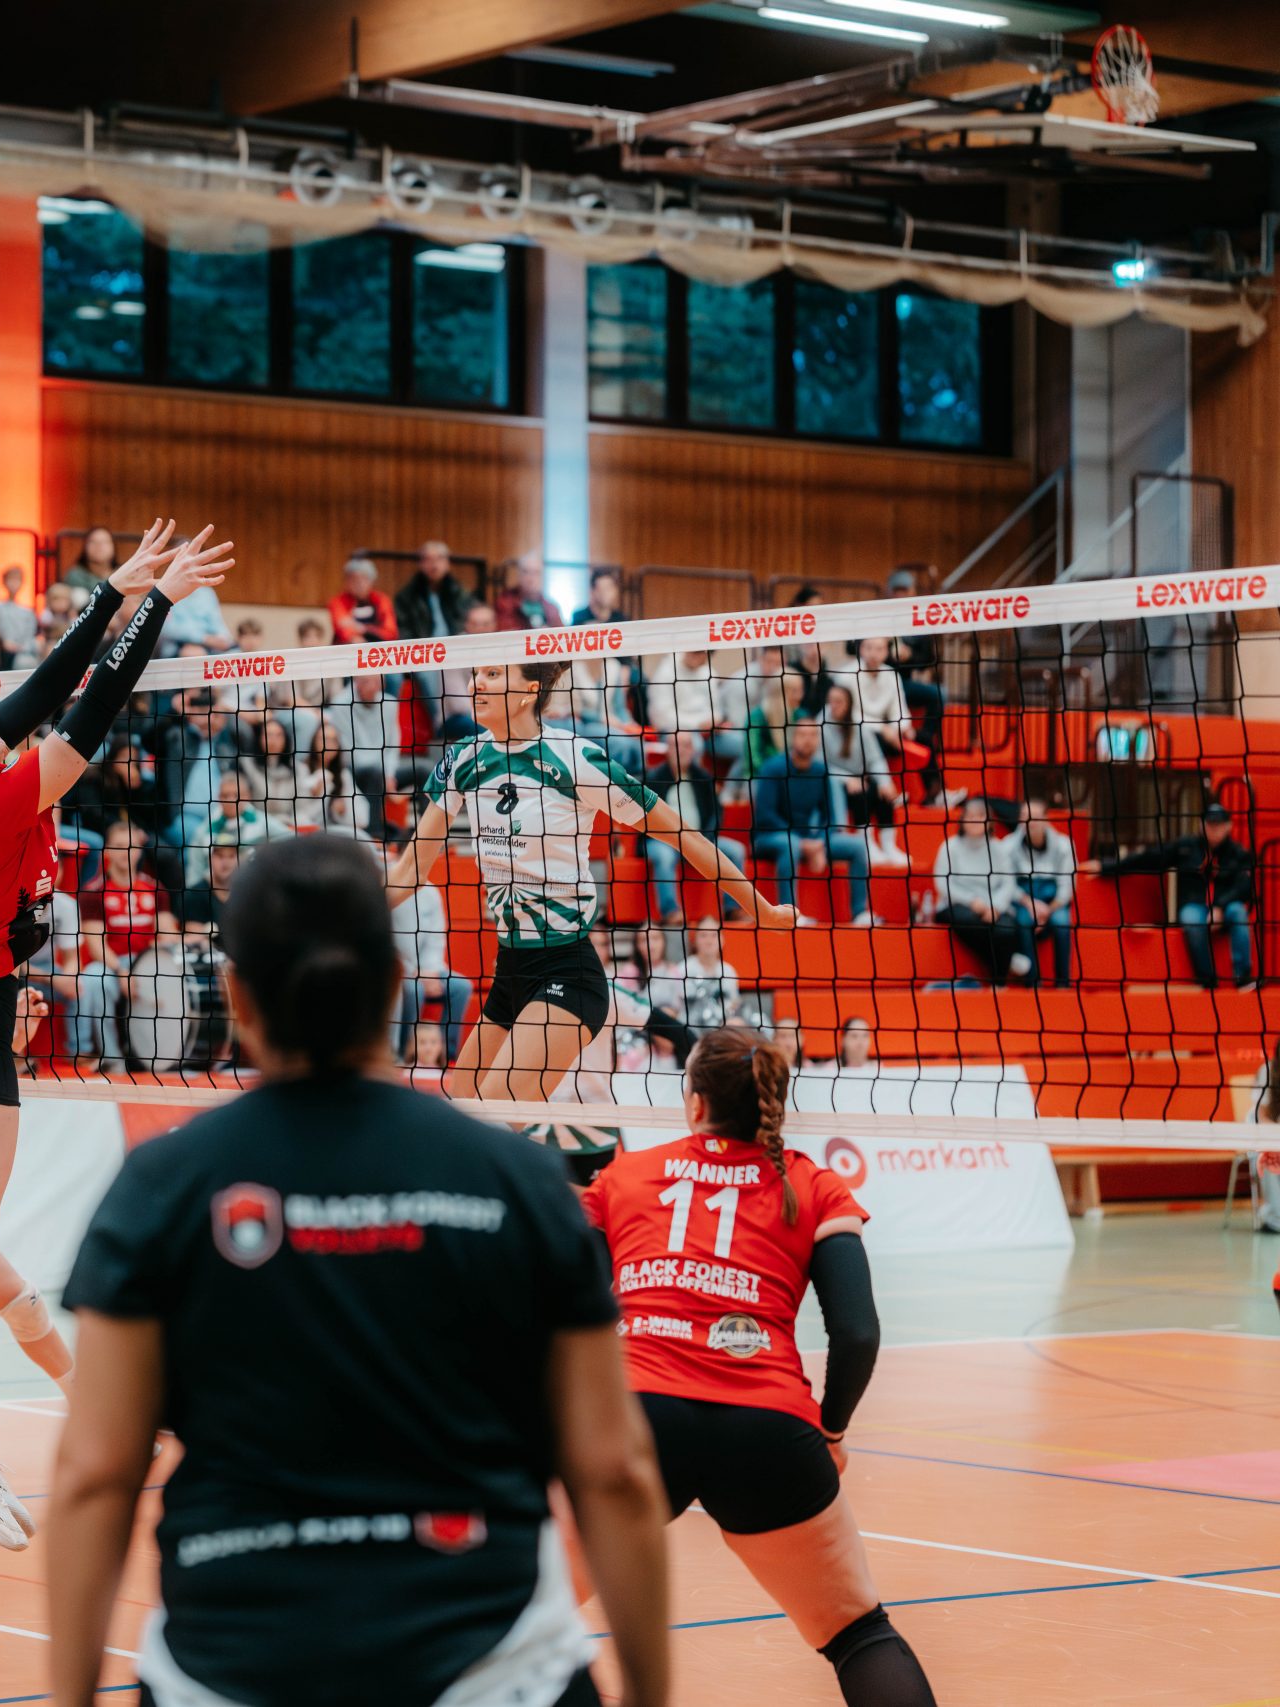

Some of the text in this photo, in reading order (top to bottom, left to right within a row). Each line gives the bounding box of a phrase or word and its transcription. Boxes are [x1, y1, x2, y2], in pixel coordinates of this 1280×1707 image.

[1136, 574, 1268, 608] Lexware
[912, 595, 1031, 627] Lexware
[106, 597, 154, 671] Lexware
[525, 629, 623, 656] Lexware
[709, 612, 816, 642] Lexware
[203, 655, 286, 680] Lexware
[357, 642, 447, 669] Lexware
[496, 783, 518, 814] 8
[664, 1158, 761, 1185] WANNER
[877, 1141, 1010, 1173] markant
[658, 1179, 740, 1259] 11
[620, 1258, 761, 1292] BLACK FOREST
[620, 1274, 760, 1303] VOLLEYS OFFENBURG
